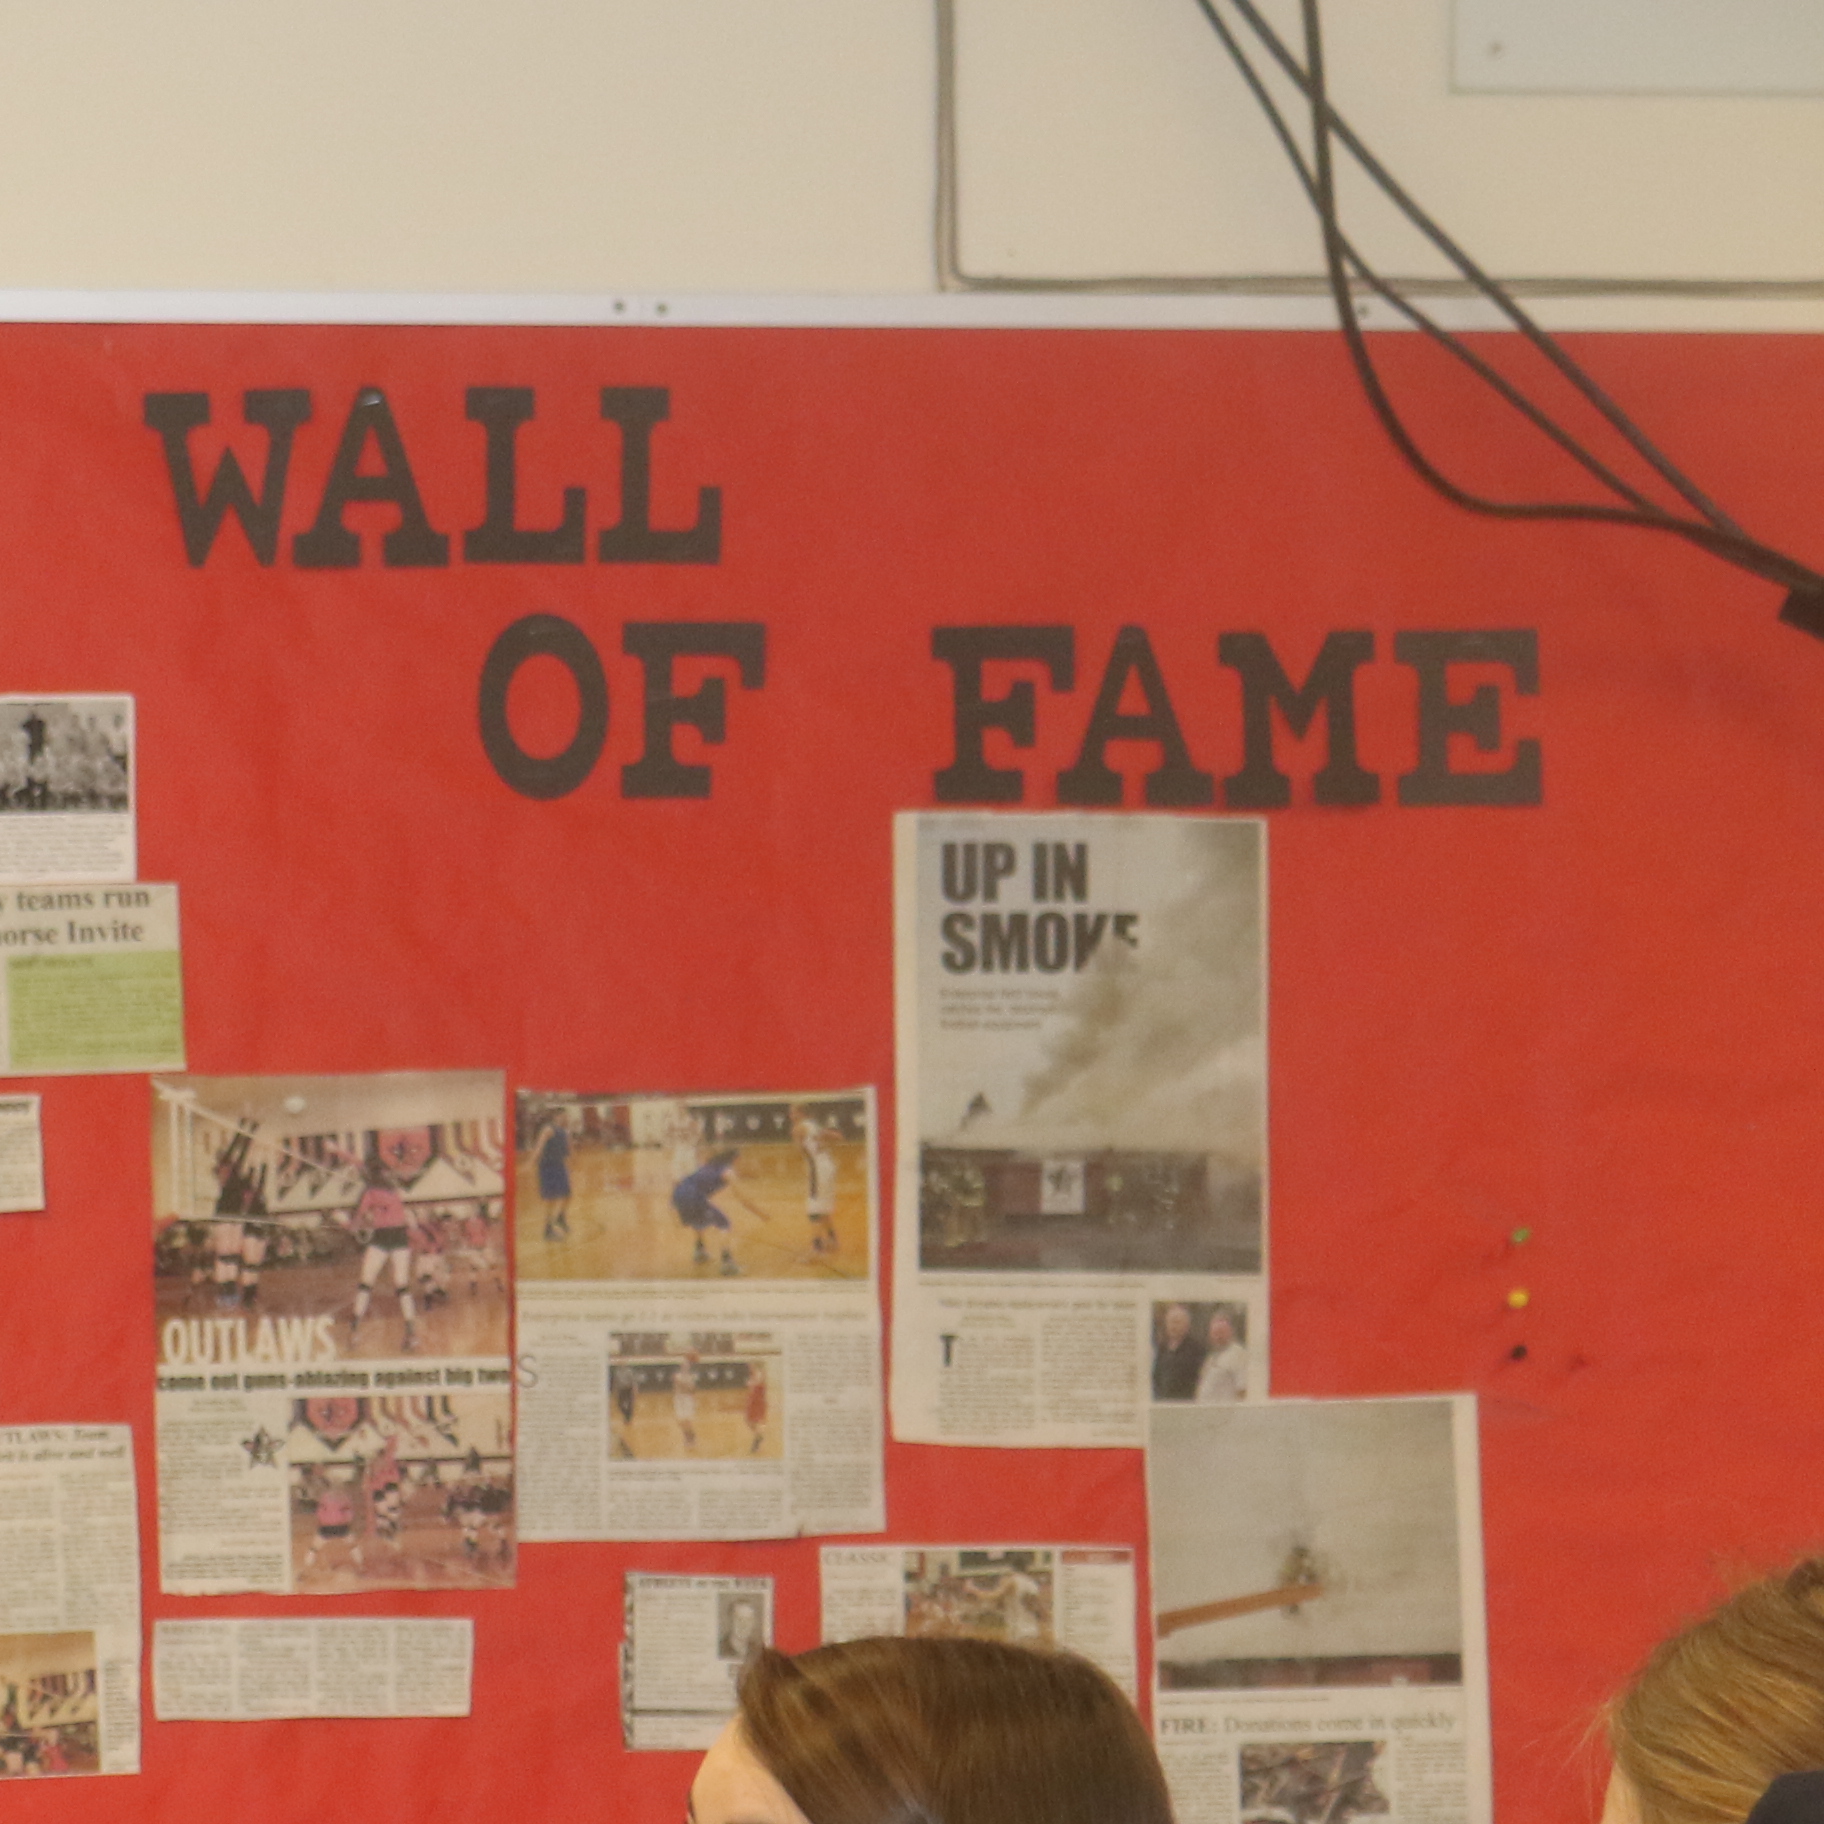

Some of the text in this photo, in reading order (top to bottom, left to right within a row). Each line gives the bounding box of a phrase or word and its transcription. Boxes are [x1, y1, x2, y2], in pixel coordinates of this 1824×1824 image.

[143, 385, 722, 569] WALL
[478, 612, 1543, 809] OF FAME
[942, 841, 1088, 904] UP IN
[16, 891, 93, 911] teams
[103, 890, 150, 908] run
[68, 921, 143, 944] Invite
[163, 1316, 337, 1365] OUTLAWS
[940, 1334, 959, 1367] T
[1225, 1717, 1311, 1734] Donations
[1317, 1718, 1363, 1731] come
[1370, 1716, 1385, 1729] in
[1391, 1711, 1453, 1732] quickly
